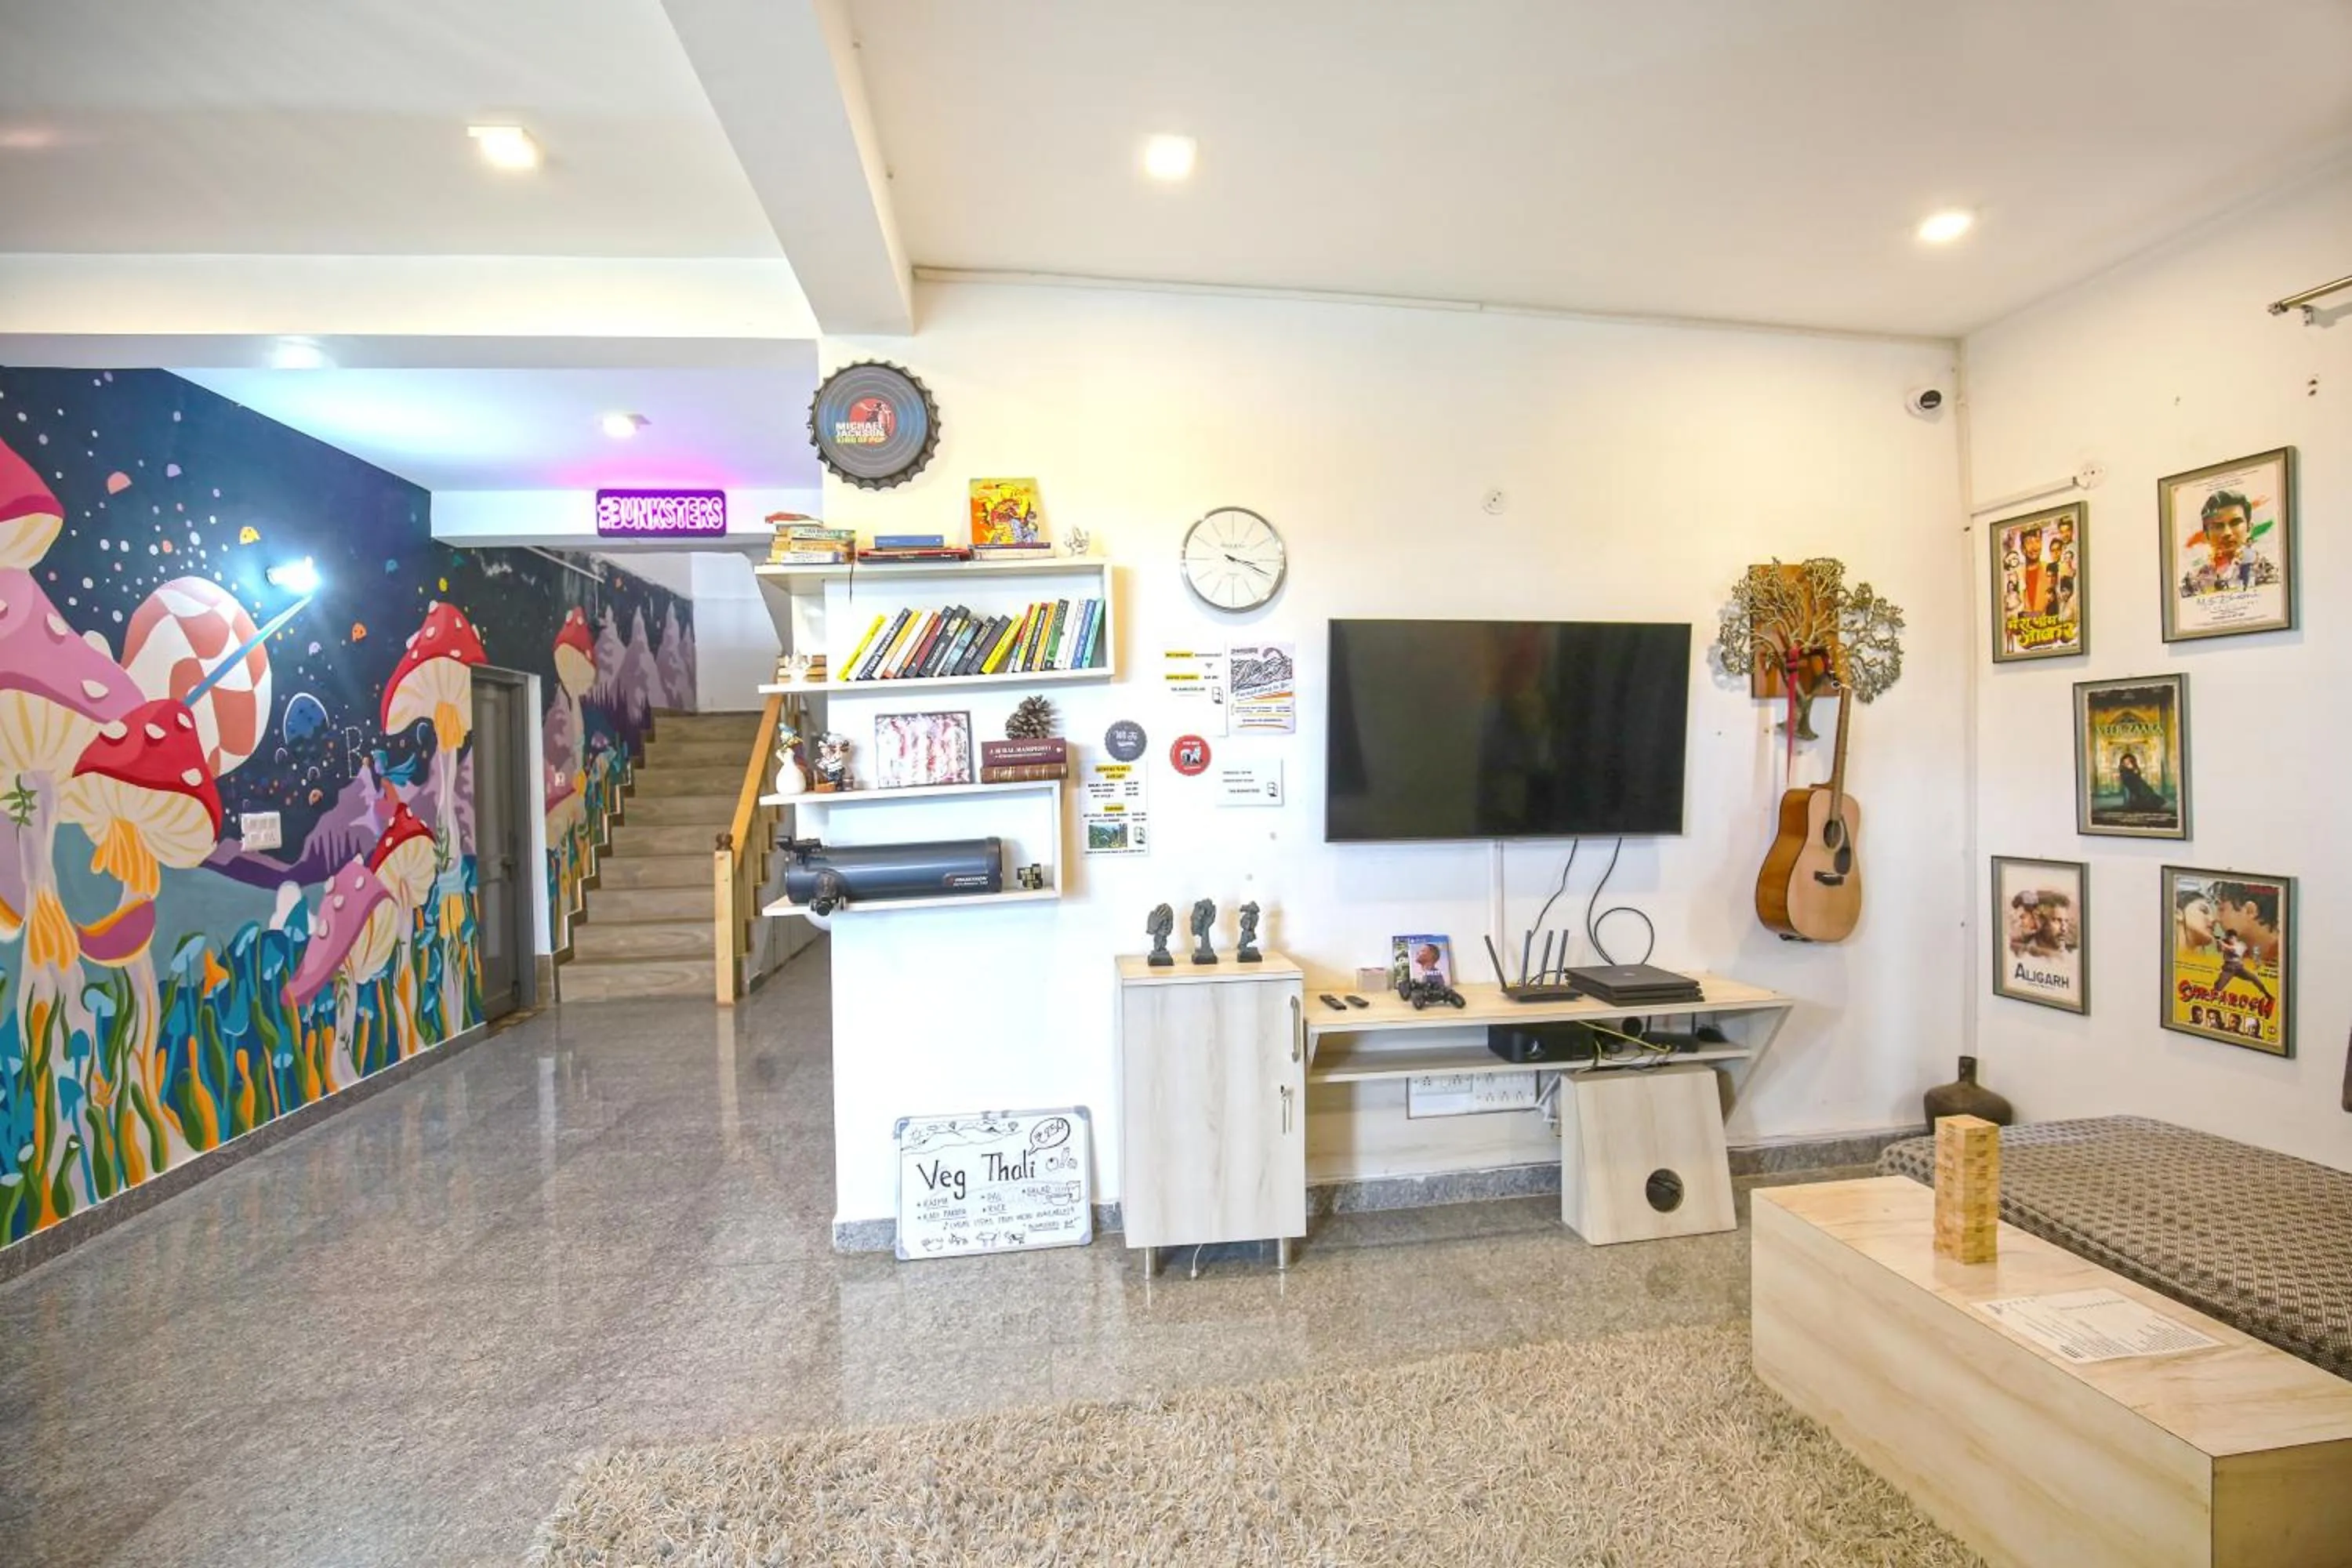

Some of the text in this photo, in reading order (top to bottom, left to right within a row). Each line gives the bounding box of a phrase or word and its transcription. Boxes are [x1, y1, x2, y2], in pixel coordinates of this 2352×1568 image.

[2014, 962, 2070, 989] ALIGARH
[916, 1149, 1036, 1200] Veg Thali
